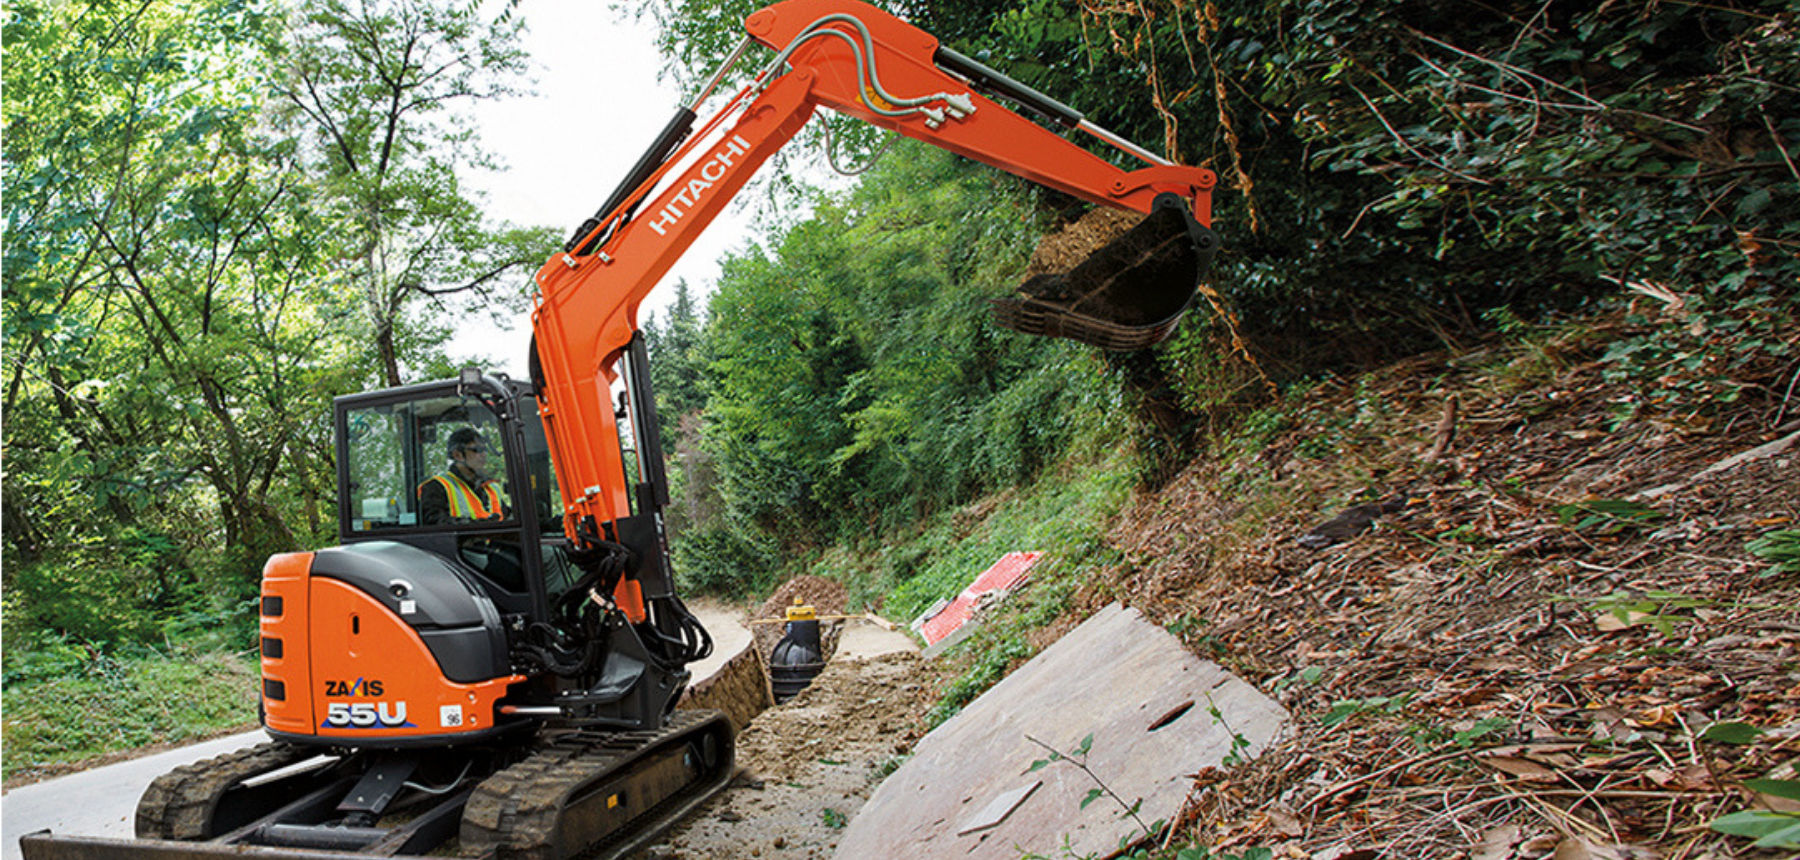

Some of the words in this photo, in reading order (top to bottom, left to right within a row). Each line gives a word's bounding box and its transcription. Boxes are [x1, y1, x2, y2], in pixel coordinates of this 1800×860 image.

[648, 134, 752, 236] HITACHI
[325, 677, 385, 697] ZAXIS
[327, 701, 408, 727] 55U
